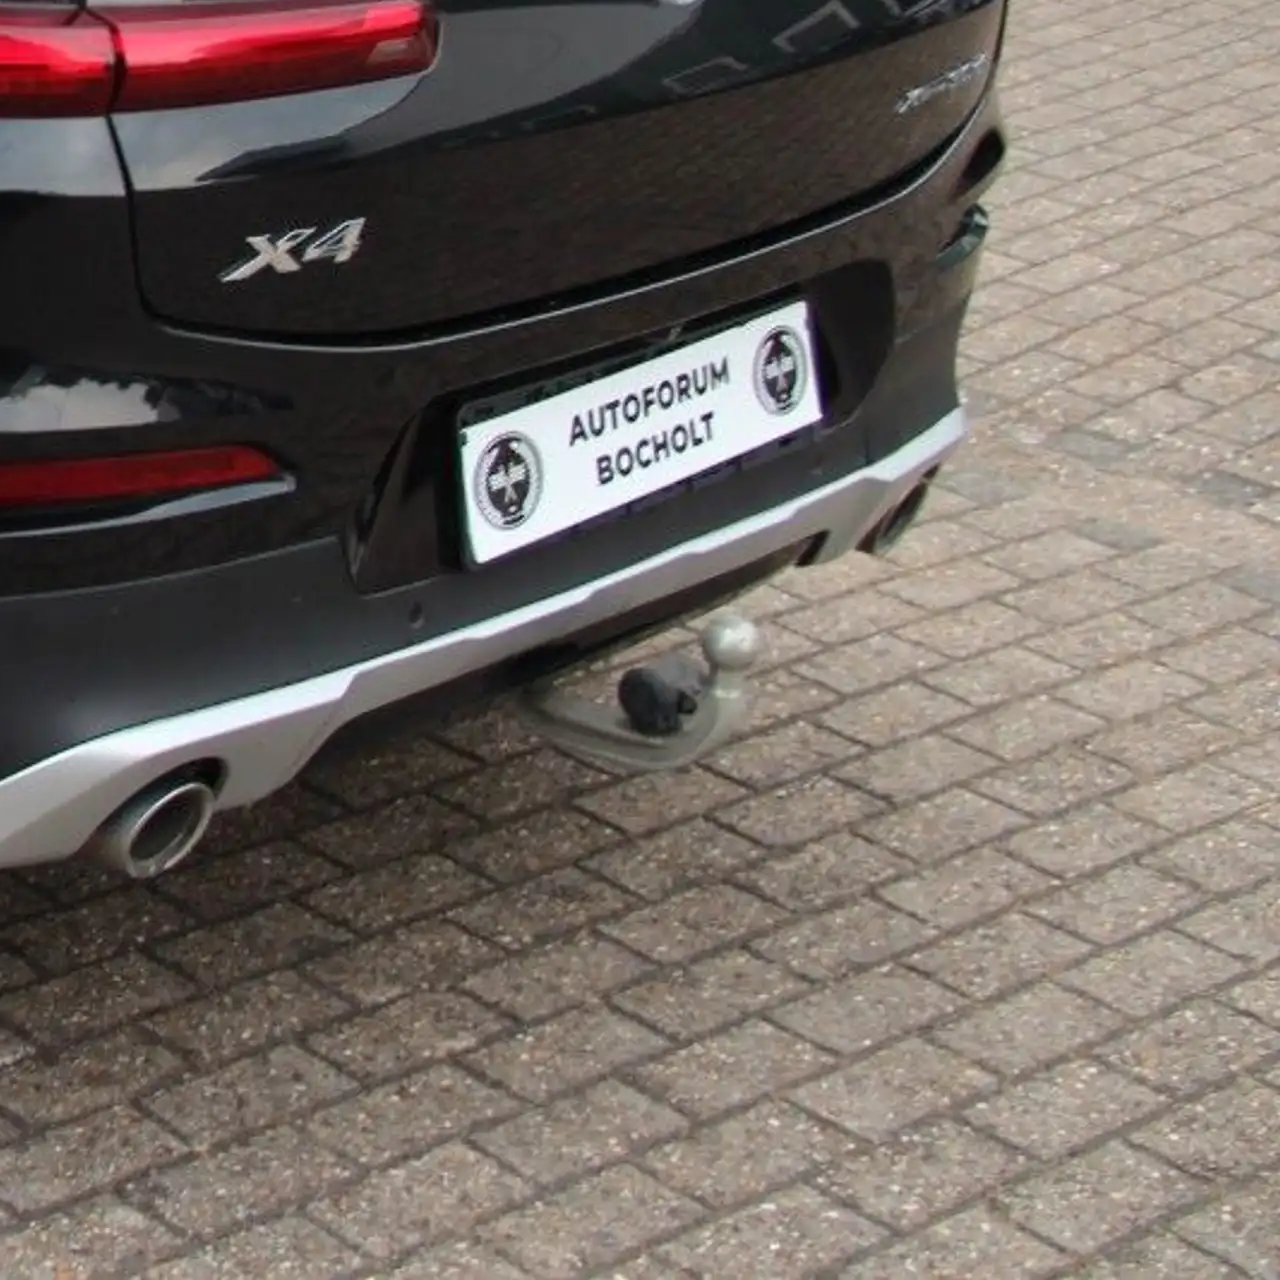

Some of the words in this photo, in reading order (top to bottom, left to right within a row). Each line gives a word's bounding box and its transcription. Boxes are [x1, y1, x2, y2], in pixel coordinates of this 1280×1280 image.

[216, 217, 366, 283] X4
[569, 357, 729, 447] AUTOFORUM
[596, 411, 714, 485] BOCHOLT
